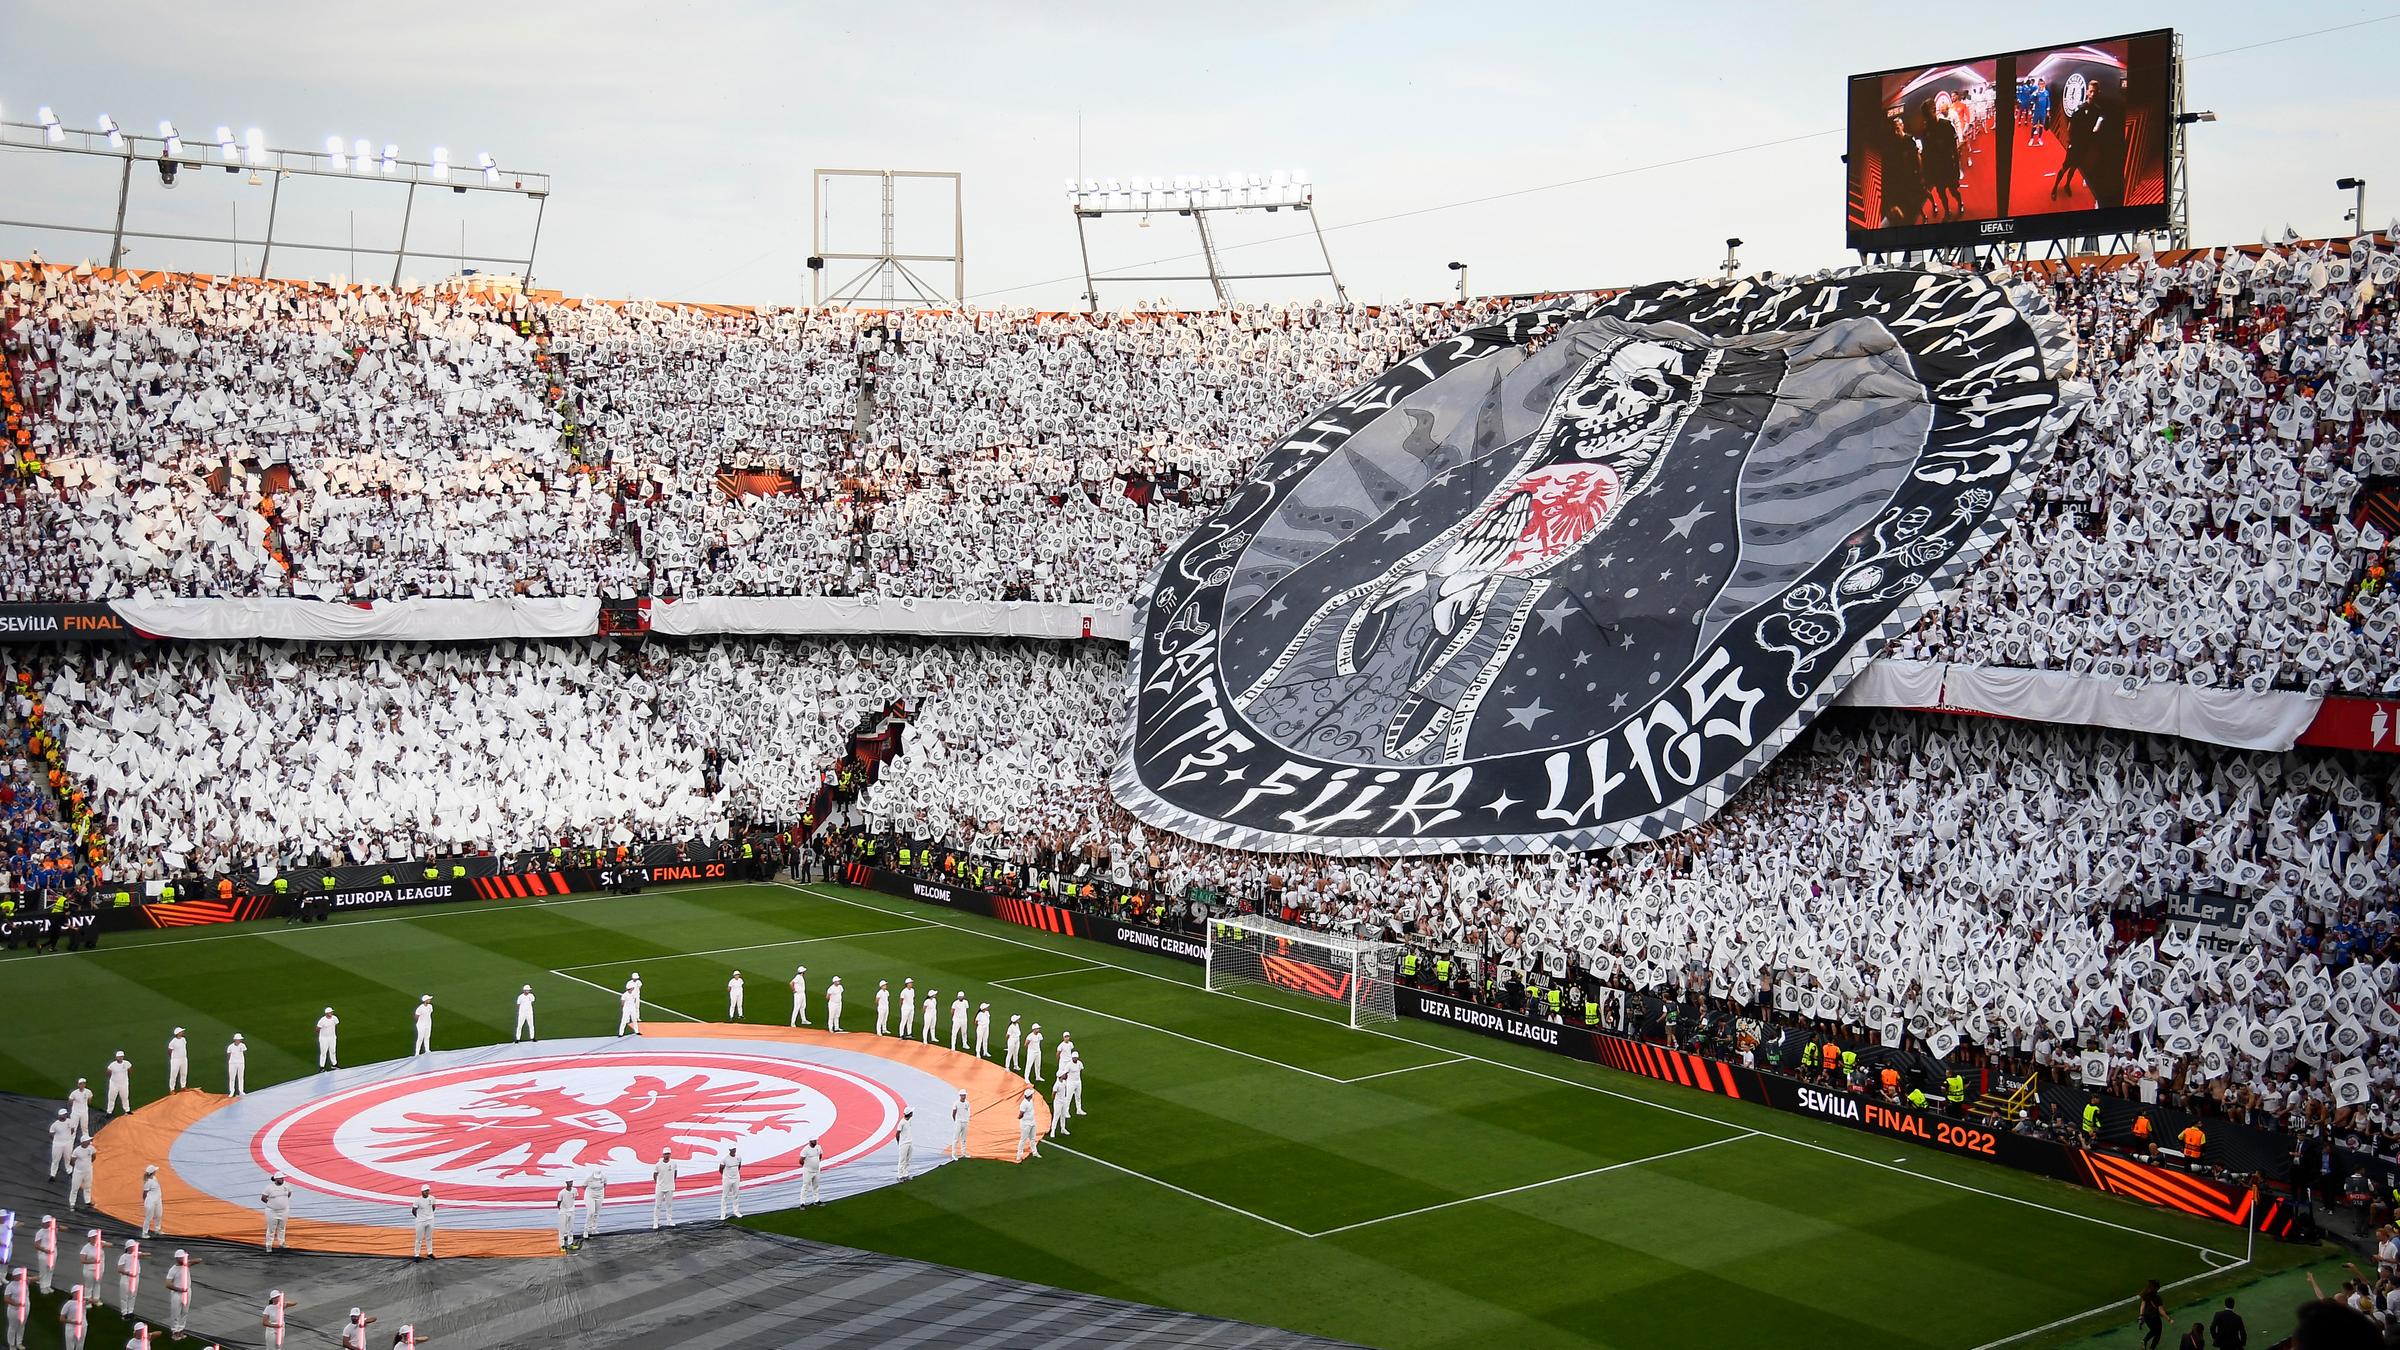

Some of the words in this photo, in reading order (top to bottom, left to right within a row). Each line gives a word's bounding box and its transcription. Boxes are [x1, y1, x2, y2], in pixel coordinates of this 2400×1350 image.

[1980, 222, 2014, 233] UEFA.tv
[64, 615, 124, 631] FINAL
[1339, 617, 1361, 666] Heilige
[653, 865, 702, 881] FINAL
[336, 890, 393, 906] EUROPA
[397, 885, 452, 901] LEAGUE
[912, 883, 952, 902] WELCOME
[1117, 928, 1160, 948] OPENING
[1420, 998, 1452, 1019] UEFA
[1454, 1006, 1505, 1032] EUROPA
[1507, 1019, 1558, 1045] LEAGUE
[2161, 1058, 2169, 1067] 12
[1865, 1104, 1931, 1139] FINAL
[1937, 1122, 1996, 1155] 2022
